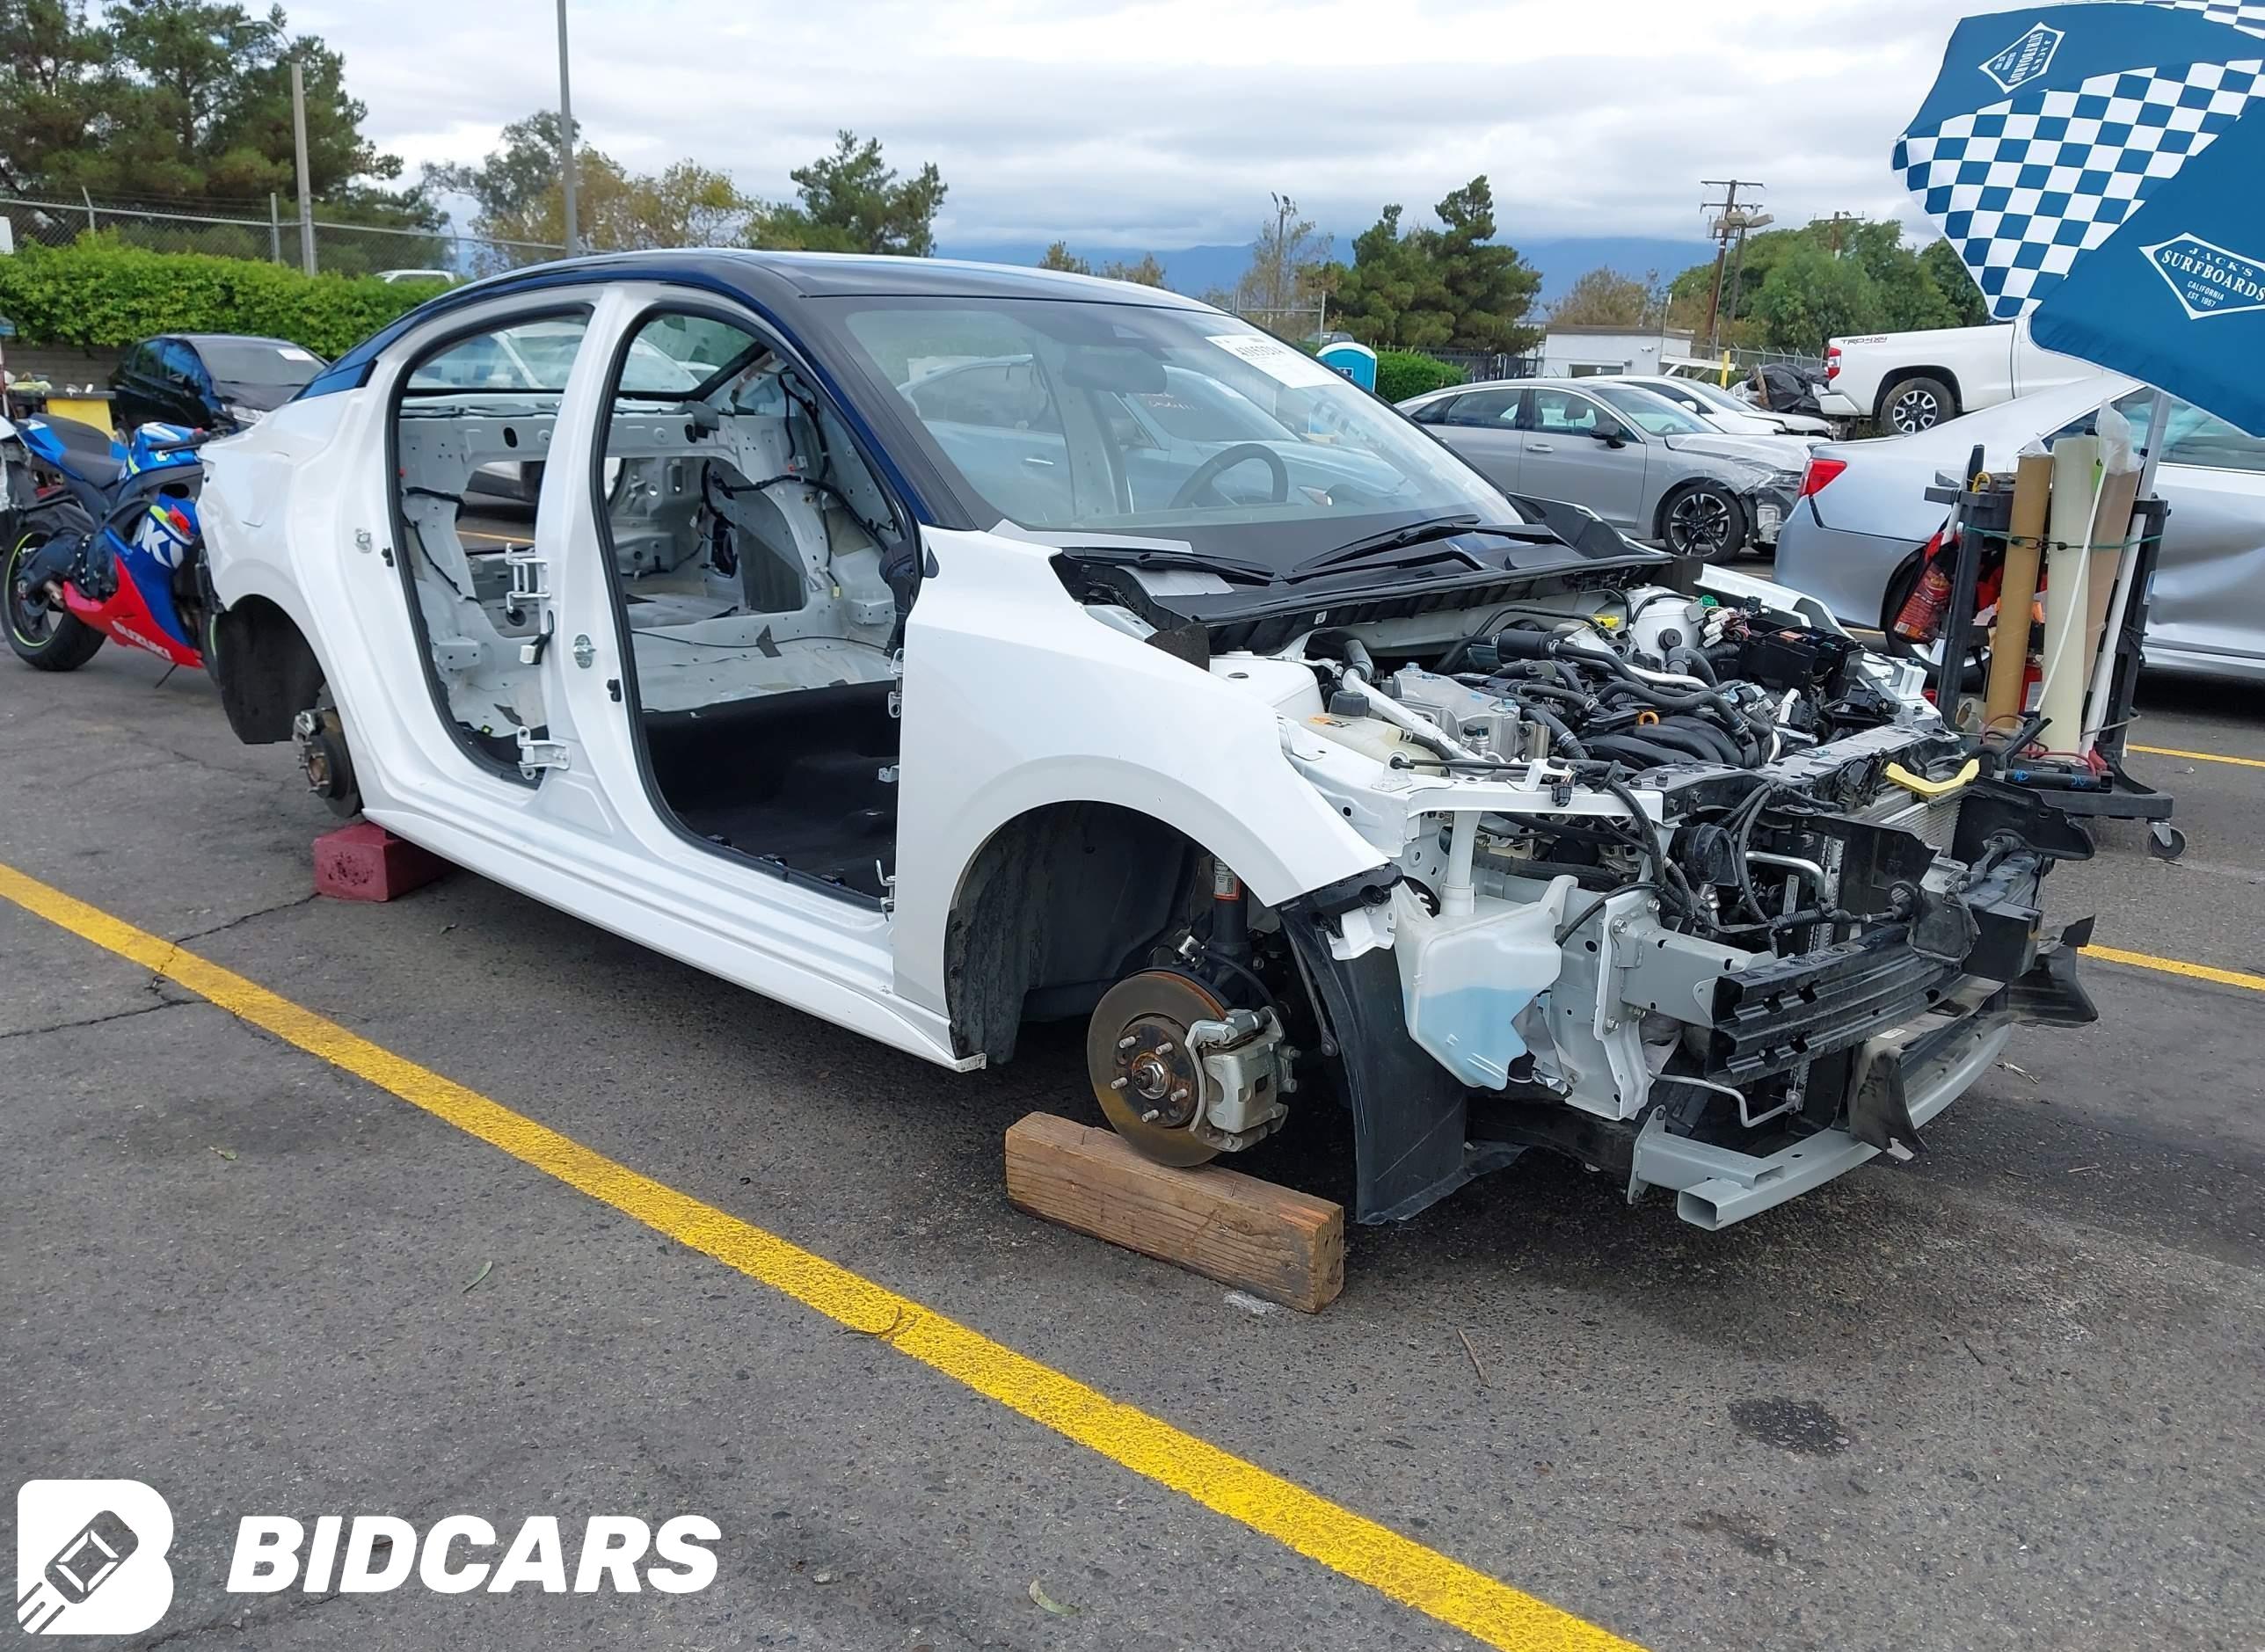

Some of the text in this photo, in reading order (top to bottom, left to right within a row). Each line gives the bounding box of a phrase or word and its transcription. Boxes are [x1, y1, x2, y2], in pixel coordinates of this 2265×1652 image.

[2006, 32, 2044, 84] SURFBOARDS
[2161, 250, 2265, 302] SURFBOARDS
[2189, 248, 2254, 277] JACK'S
[2187, 280, 2225, 301] CALIFORNIA
[2201, 296, 2217, 308] 1957
